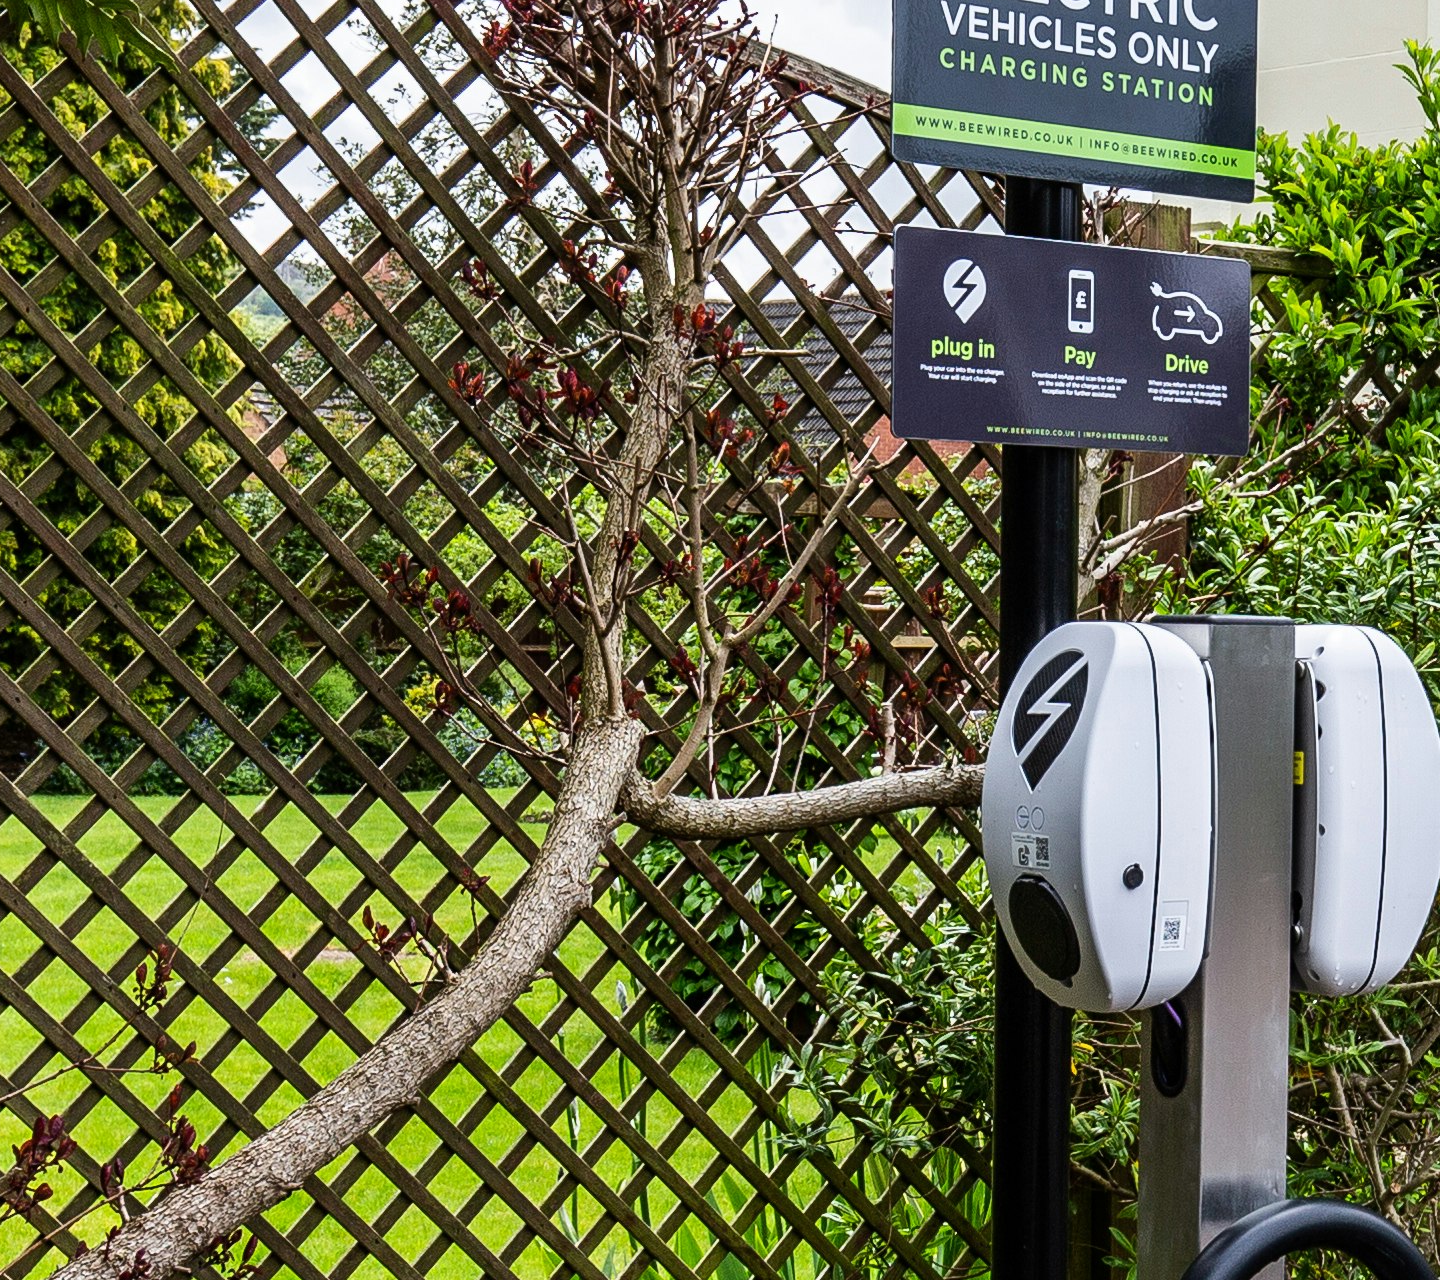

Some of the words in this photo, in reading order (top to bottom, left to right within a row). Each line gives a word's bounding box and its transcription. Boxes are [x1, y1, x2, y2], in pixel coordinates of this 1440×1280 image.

[940, 0, 1117, 60] VEHICLES
[1128, 30, 1220, 74] ONLY
[939, 47, 1088, 88] CHARGING
[1101, 71, 1214, 107] STATION
[915, 115, 1074, 146] WWW.BEEWIRED.CO.UK
[1089, 138, 1239, 168] INFO@BEEWIRED.CO.UK
[1075, 290, 1087, 309] £
[931, 335, 973, 361] plug
[978, 338, 995, 359] in
[1064, 345, 1097, 369] Pay
[1165, 353, 1209, 375] Drive
[986, 425, 1075, 438] WWW.BEEWIRED.CO.UK
[1083, 431, 1169, 443] INFO@BEEWIRED.CO.UK
